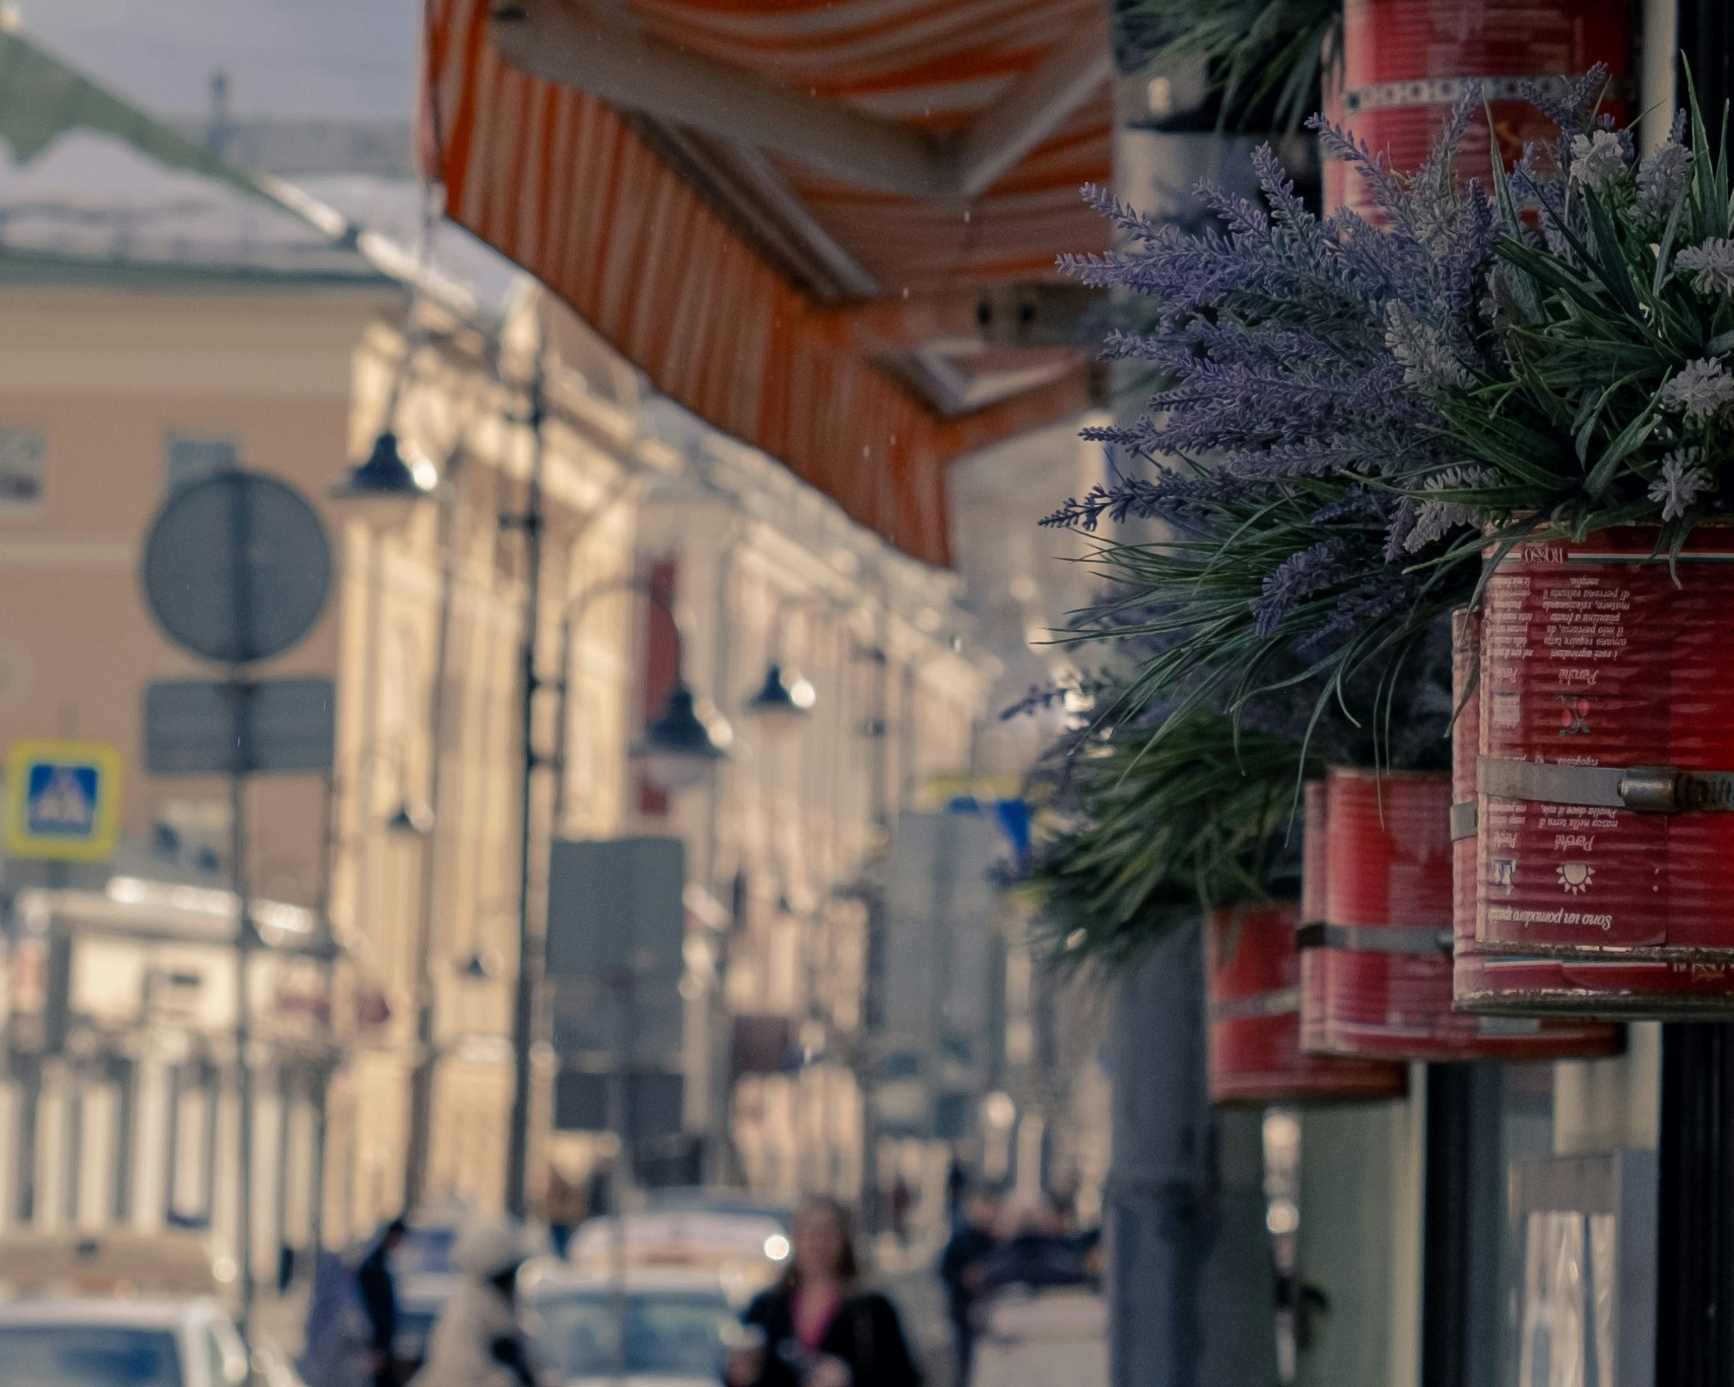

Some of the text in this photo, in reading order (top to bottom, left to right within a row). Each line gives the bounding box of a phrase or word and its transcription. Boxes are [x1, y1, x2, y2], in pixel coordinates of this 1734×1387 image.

[1554, 834, 1596, 852] Perché
[1513, 907, 1564, 928] pomodoro
[1563, 912, 1581, 925] un
[1582, 914, 1613, 931] Sono
